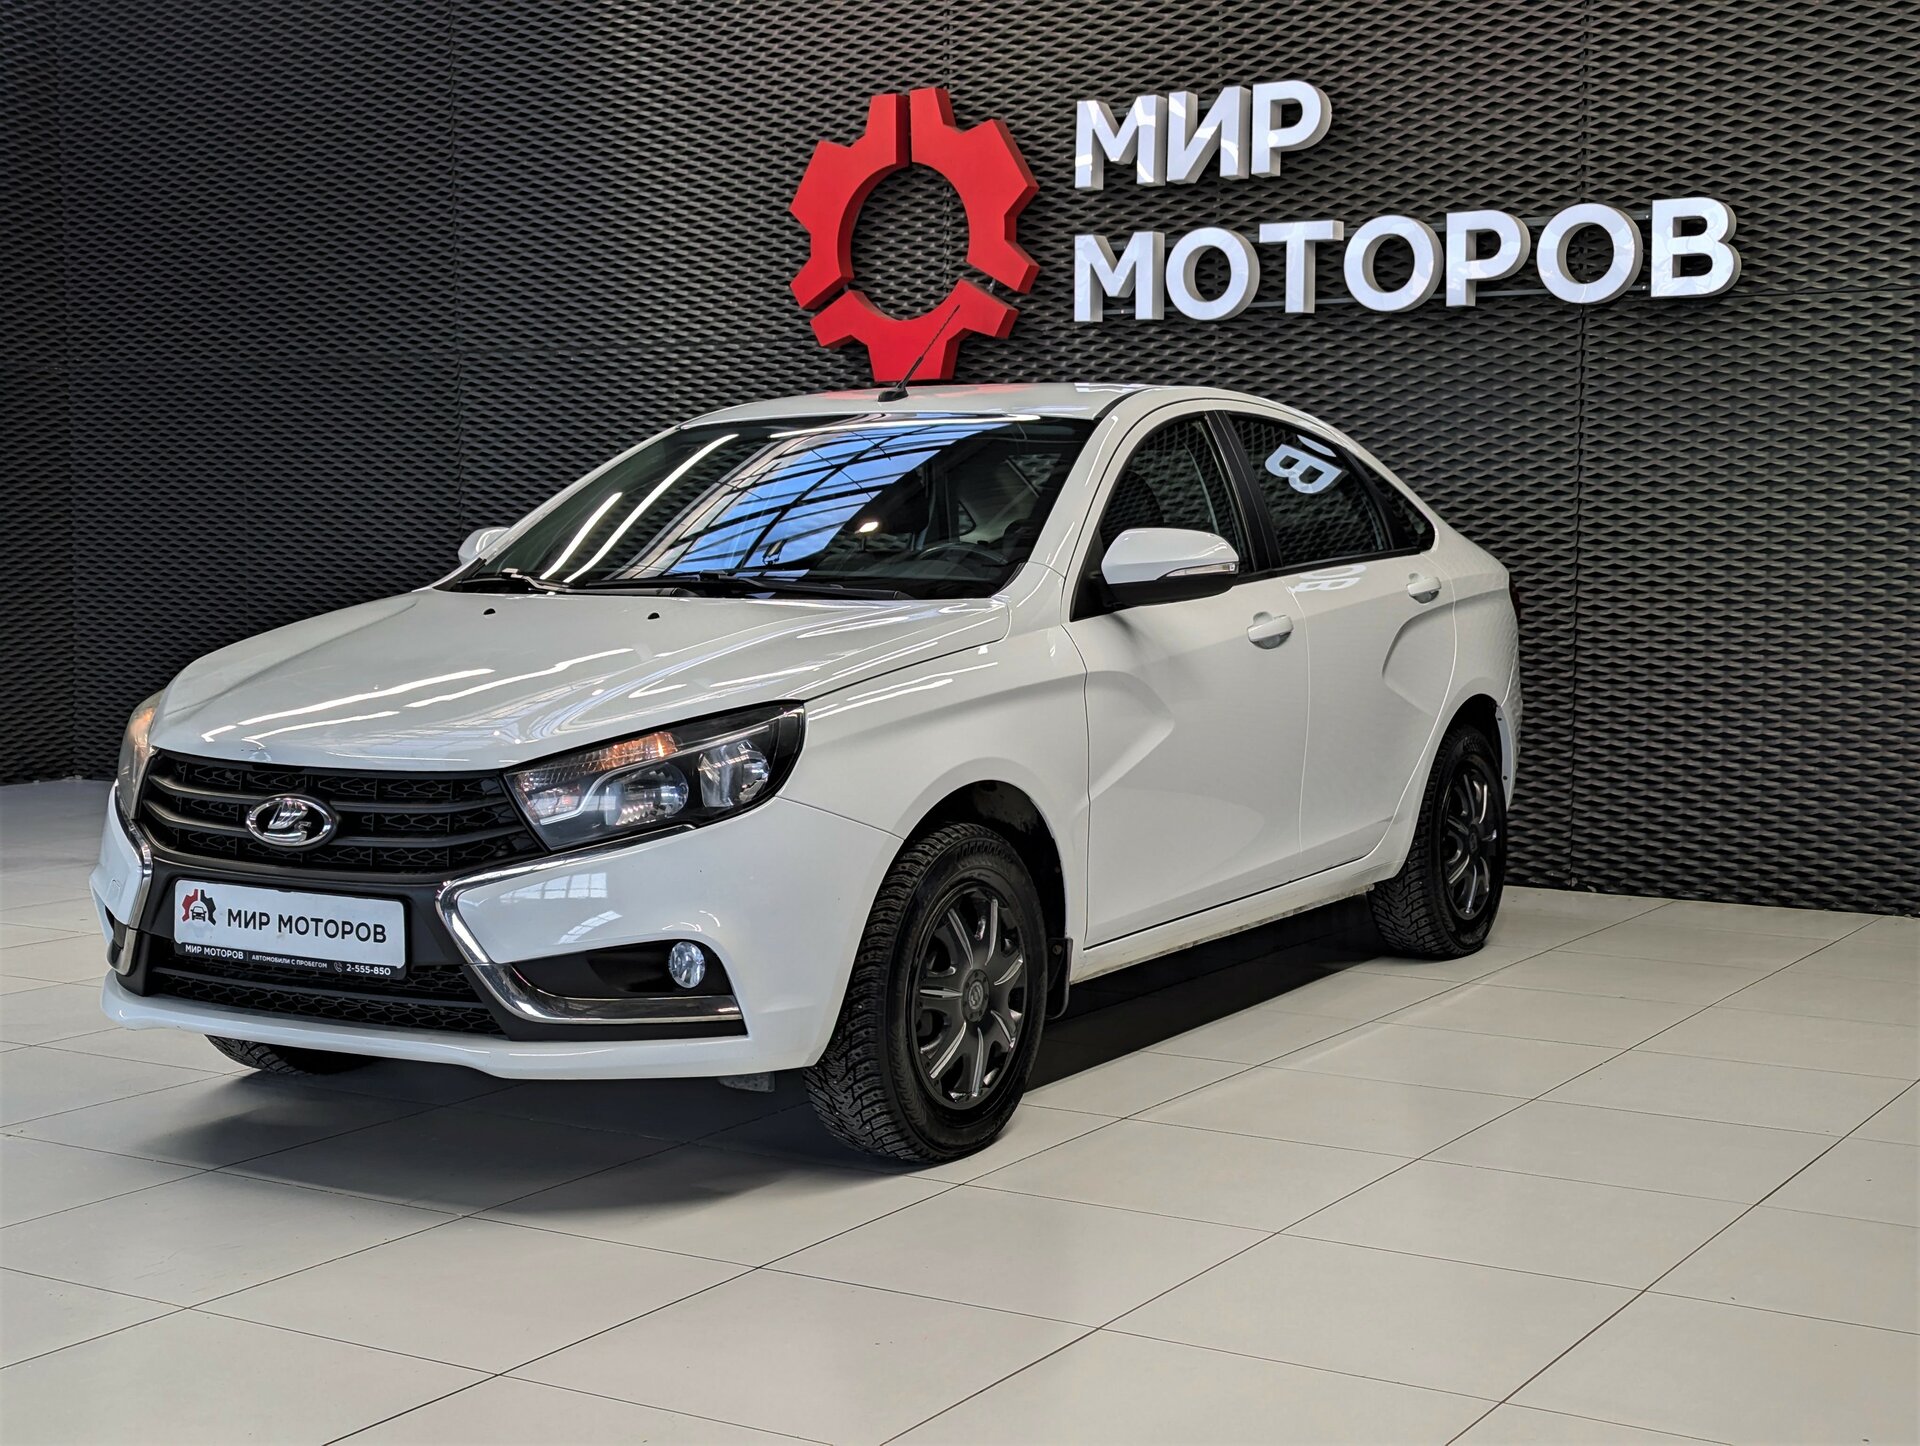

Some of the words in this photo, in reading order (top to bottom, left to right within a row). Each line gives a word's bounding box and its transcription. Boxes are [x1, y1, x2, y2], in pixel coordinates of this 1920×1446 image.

[1075, 80, 1332, 190] МИР
[1074, 197, 1741, 323] МОТОРОВ
[227, 908, 271, 931] МИР
[278, 914, 387, 943] МОТОРОВ
[185, 944, 202, 954] МИР
[204, 946, 244, 960] МОТОРОВ
[251, 954, 290, 965] АВТОМОБИЛИ
[296, 960, 327, 968] ПРОБЕГОМ
[346, 963, 391, 976] 2-555-850
